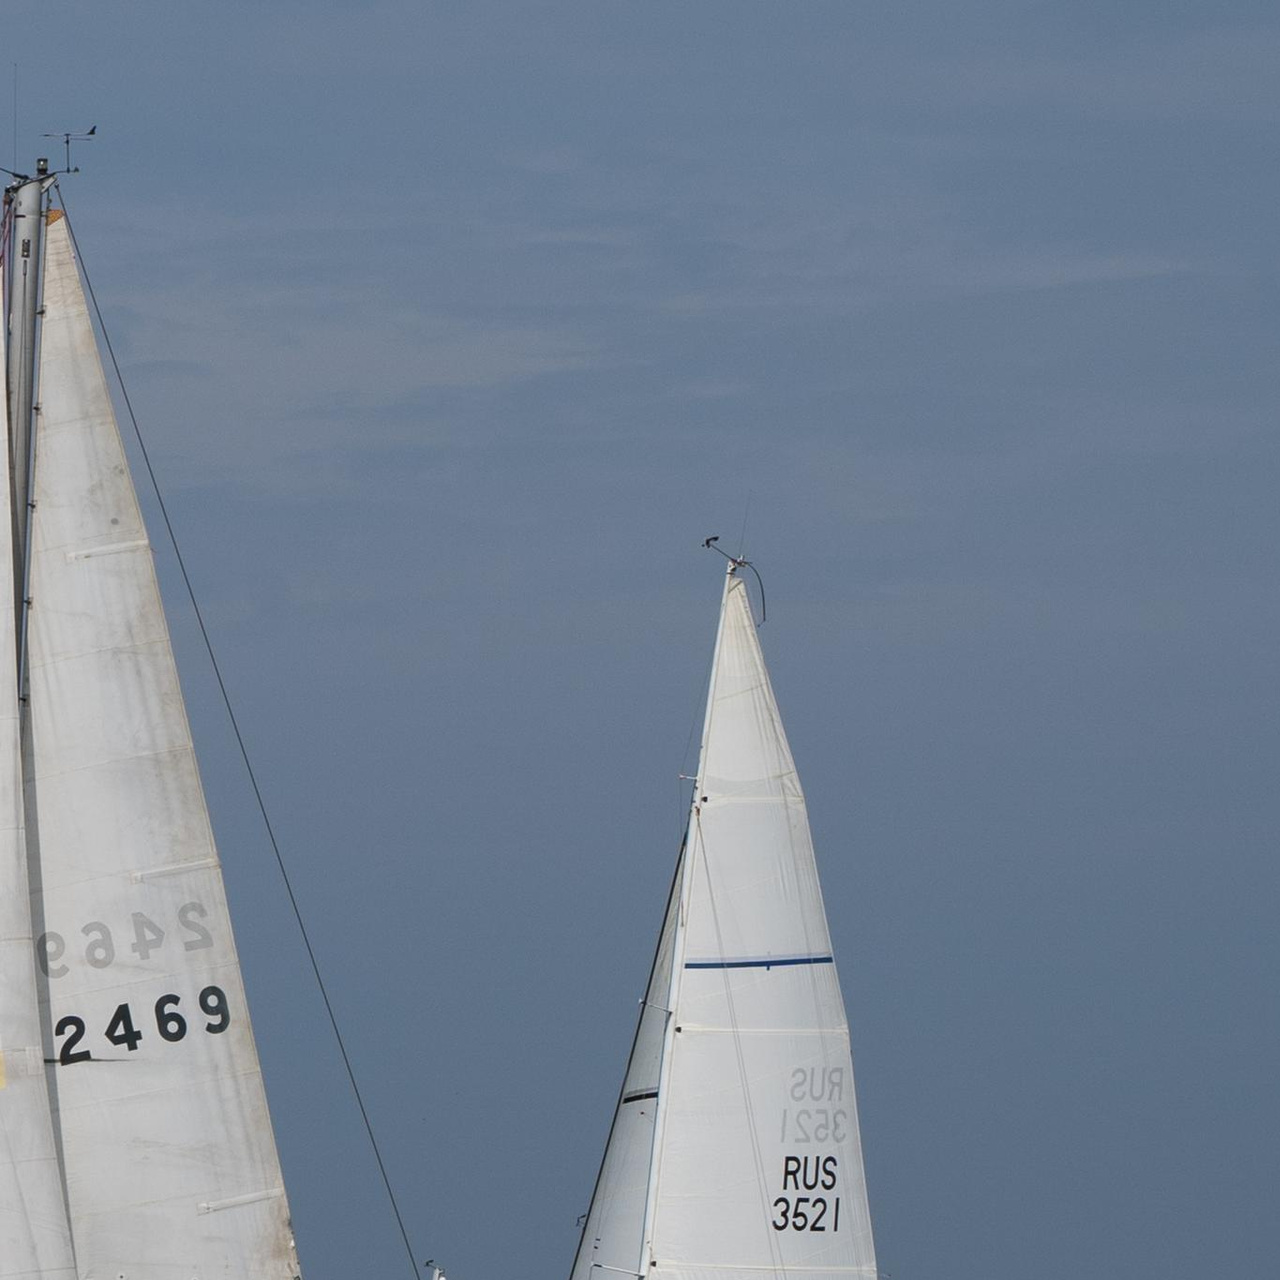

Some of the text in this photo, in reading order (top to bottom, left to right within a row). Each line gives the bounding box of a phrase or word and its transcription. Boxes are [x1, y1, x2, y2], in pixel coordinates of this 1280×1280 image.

[54, 985, 231, 1066] 2469
[782, 1155, 838, 1191] RUS
[772, 1197, 840, 1232] 3521
